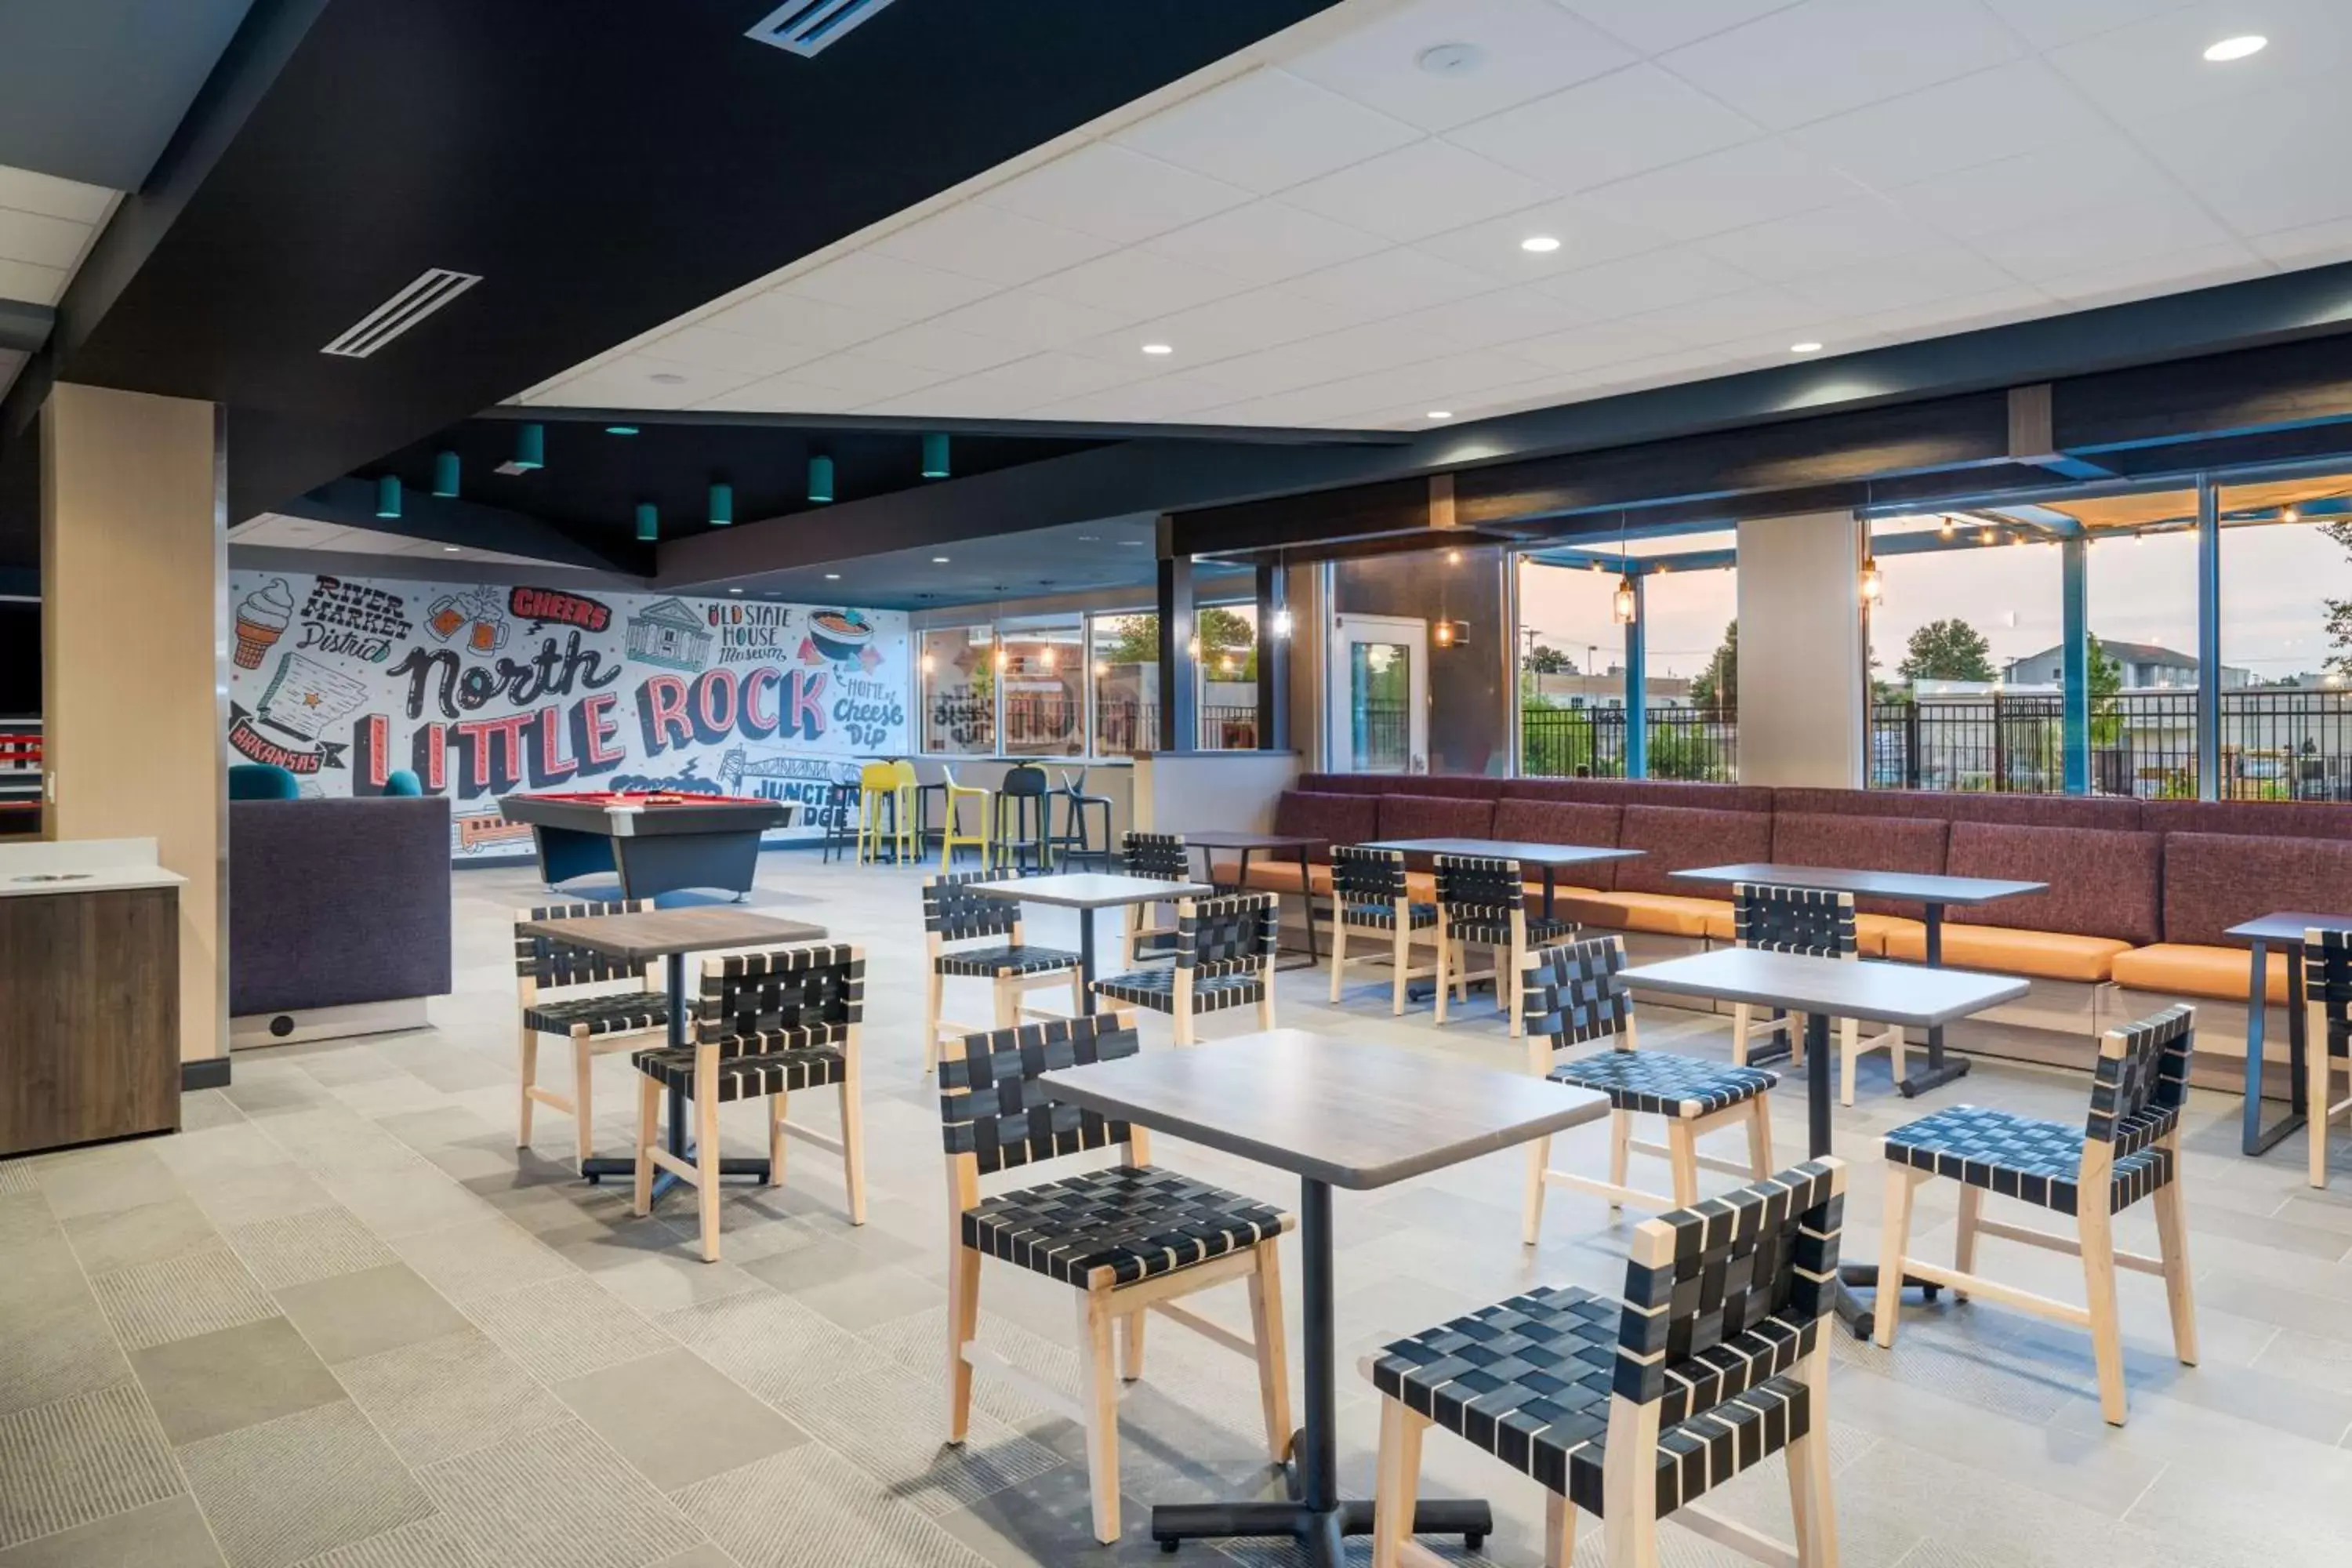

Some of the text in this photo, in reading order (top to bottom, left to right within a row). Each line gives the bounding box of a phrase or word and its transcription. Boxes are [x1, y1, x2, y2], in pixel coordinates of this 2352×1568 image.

[312, 575, 404, 619] RIVER
[514, 589, 608, 629] CHEERS
[708, 602, 792, 627] OLD STATE
[300, 597, 413, 641] MARKET
[723, 626, 779, 647] HOUSE
[296, 621, 391, 663] District
[718, 647, 787, 665] Museum
[848, 678, 884, 700] HOME
[358, 691, 626, 793] LITTLE
[640, 666, 828, 750] ROCK
[833, 698, 904, 728] Cheese
[231, 727, 319, 771] ARKANSAS
[844, 723, 887, 750] Dip
